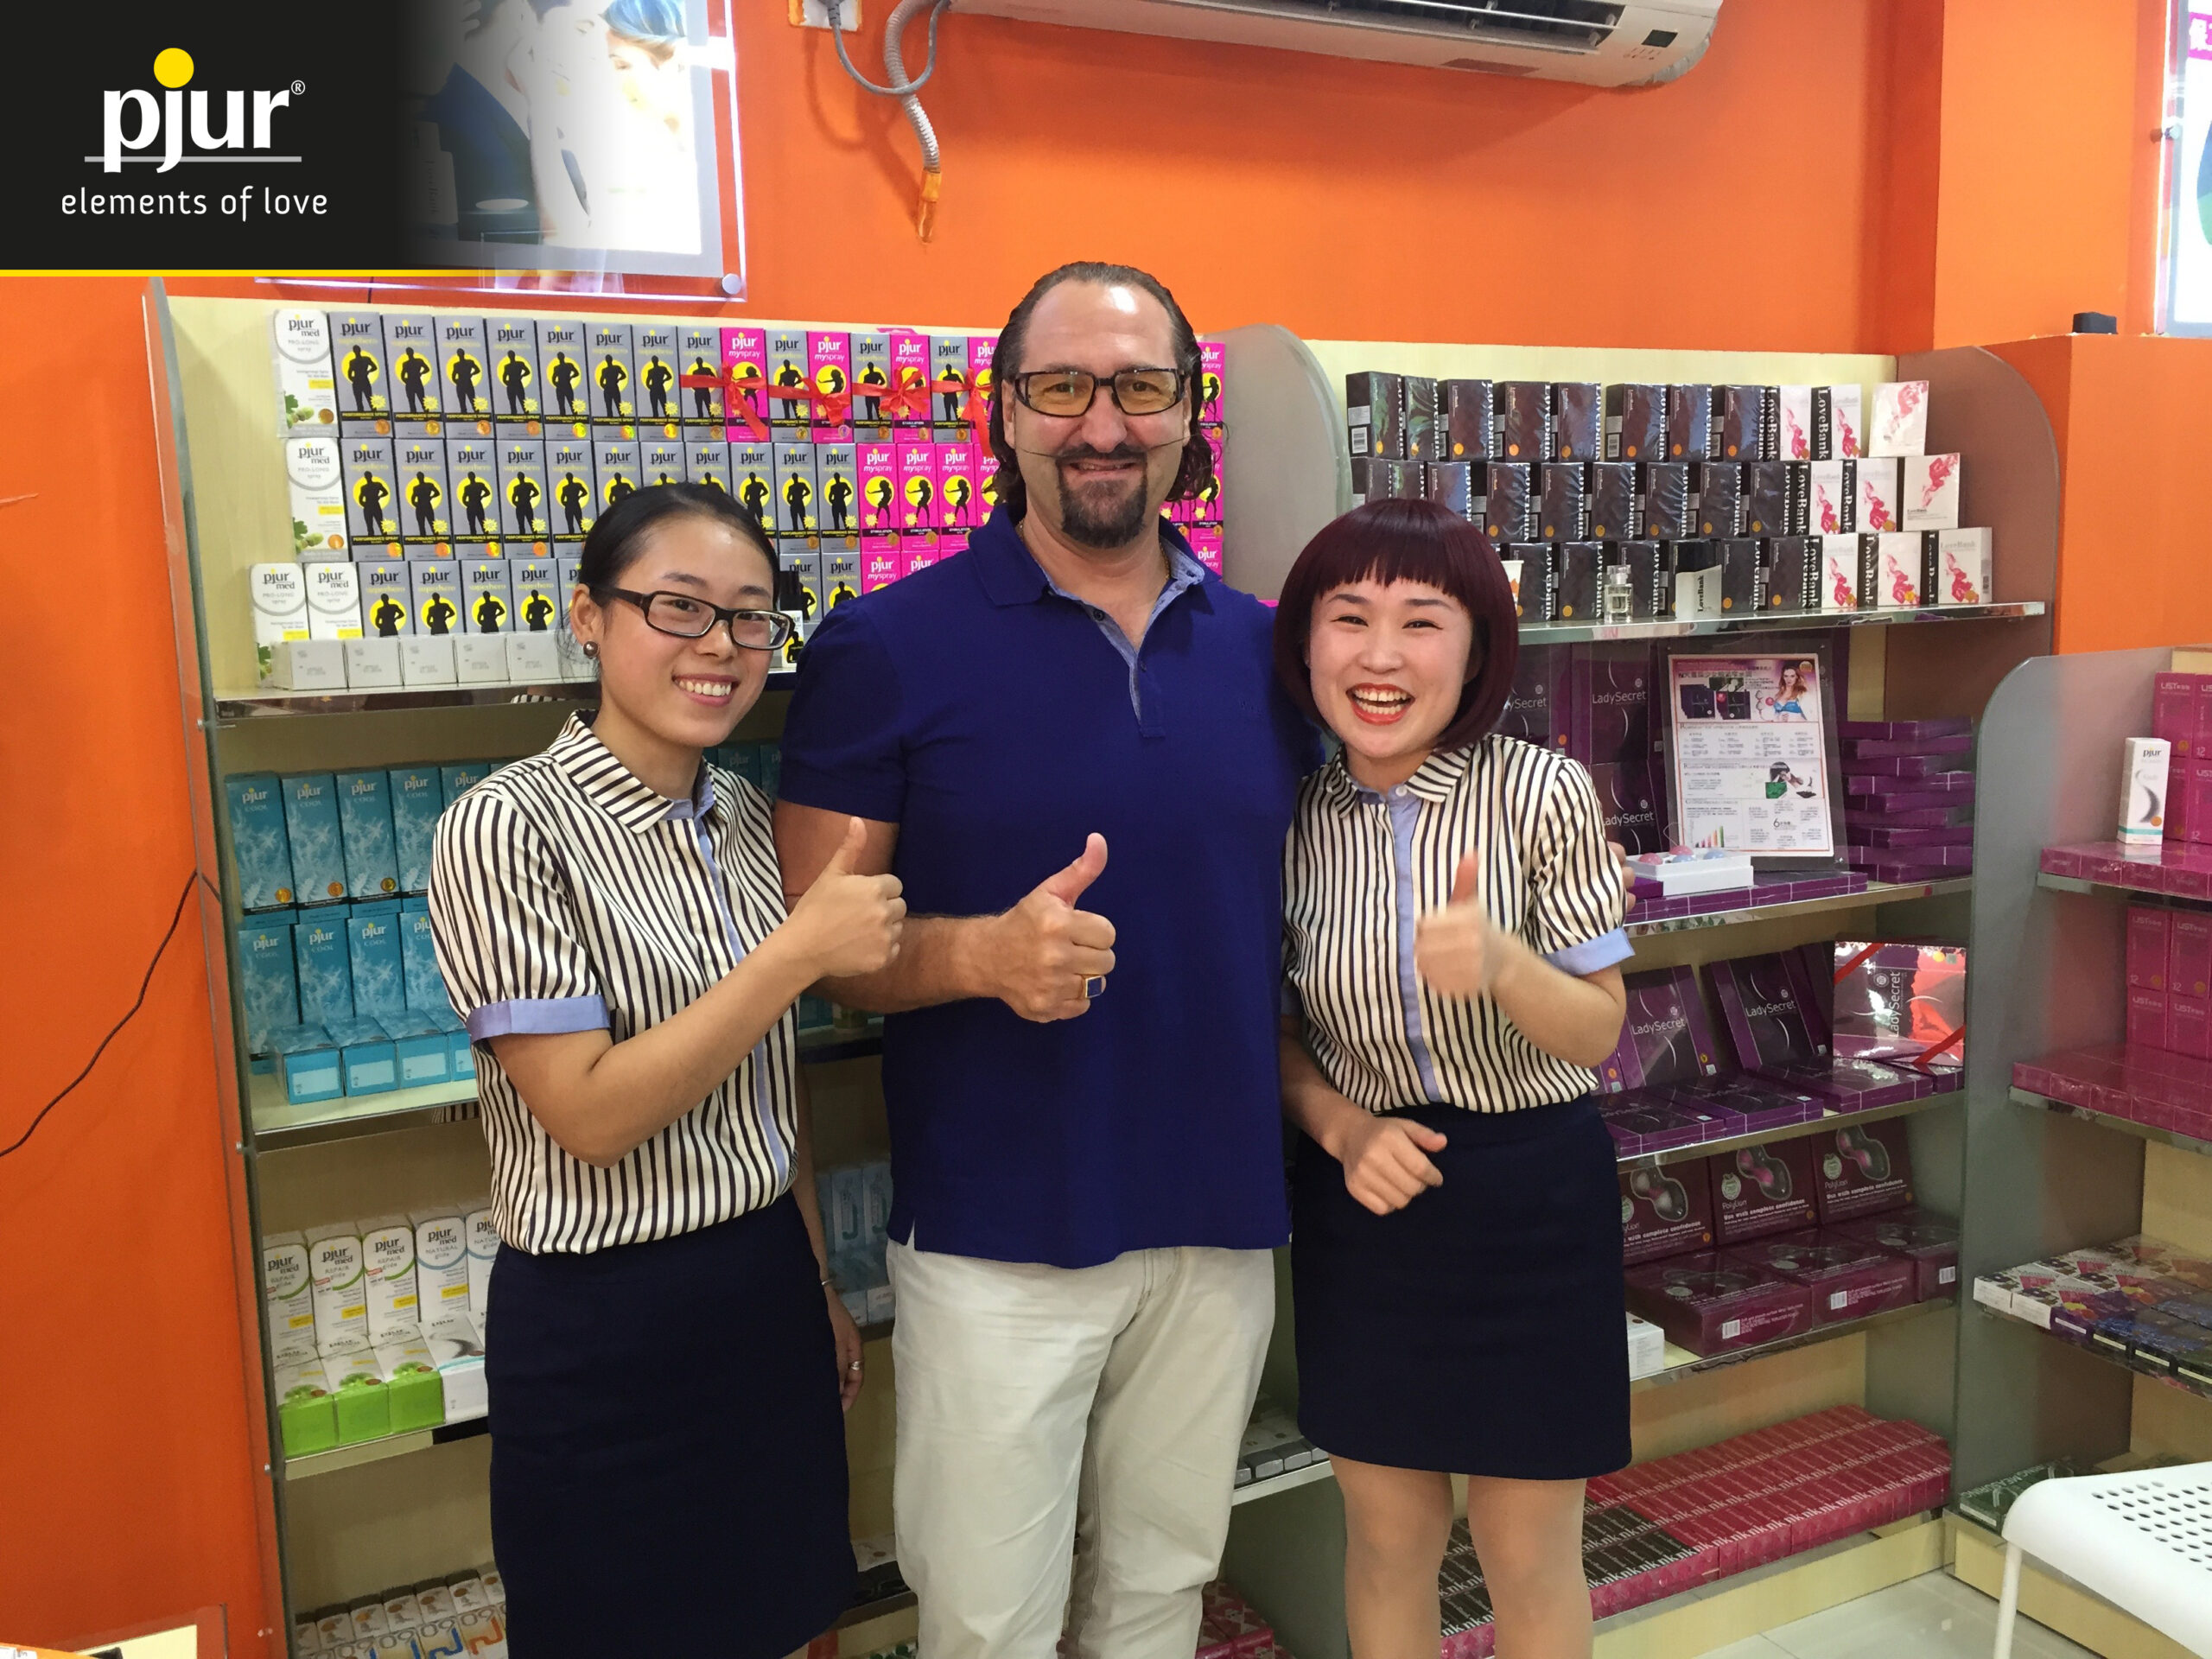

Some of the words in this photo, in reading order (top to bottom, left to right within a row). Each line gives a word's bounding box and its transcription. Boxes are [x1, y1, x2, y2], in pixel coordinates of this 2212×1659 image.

[289, 315, 315, 332] pjur
[341, 317, 371, 336] pjur
[395, 320, 423, 338] pjur
[447, 321, 474, 340] pjur
[498, 323, 524, 341] pjur
[548, 325, 575, 343] pjur
[596, 328, 622, 346] pjur
[643, 329, 668, 347] pjur
[687, 332, 712, 348] pjur
[732, 333, 757, 349] pjur
[775, 334, 798, 352] pjur
[817, 336, 842, 353] pjur
[860, 338, 883, 354] pjur
[899, 339, 922, 355] pjur
[938, 340, 961, 356] pjur
[1766, 389, 1777, 460] LoveBank
[1817, 390, 1828, 459] LoveBank
[298, 442, 324, 459] pjur
[353, 444, 383, 462] pjur
[406, 445, 434, 463] pjur
[458, 446, 485, 463] pjur
[508, 446, 534, 463] pjur
[556, 447, 582, 464] pjur
[605, 447, 631, 464] pjur
[651, 448, 676, 465] pjur
[696, 448, 721, 465] pjur
[741, 448, 765, 465] pjur
[784, 448, 807, 465] pjur
[826, 448, 849, 465] pjur
[867, 448, 890, 465] pjur
[906, 448, 929, 464] pjur
[945, 448, 967, 464] pjur
[1796, 464, 1808, 535] LoveBank
[830, 557, 854, 574] pjur
[871, 556, 894, 571] pjur
[264, 568, 289, 585] pjur
[318, 568, 344, 584] pjur
[371, 567, 399, 585] pjur
[423, 566, 450, 584] pjur
[473, 564, 500, 582] pjur
[522, 564, 548, 582] pjur
[1808, 537, 1819, 608] LoveBank
[1507, 697, 1547, 712] ySecret
[1592, 690, 1646, 706] LadySecret
[2143, 747, 2162, 759] pjur
[297, 783, 322, 799] pjur
[351, 779, 377, 795] pjur
[404, 775, 429, 791] pjur
[242, 788, 268, 804] pjur
[362, 923, 386, 938] pjur
[414, 917, 431, 931] pju
[309, 929, 334, 945] pjur
[1745, 1000, 1796, 1017] LadySecret
[1888, 971, 1902, 1037] LadySecret
[1631, 1018, 1686, 1035] LadySecret
[428, 1226, 452, 1243] pjur
[375, 1236, 399, 1253] pjur
[322, 1246, 347, 1262] pjur
[268, 1255, 294, 1272] pjur
